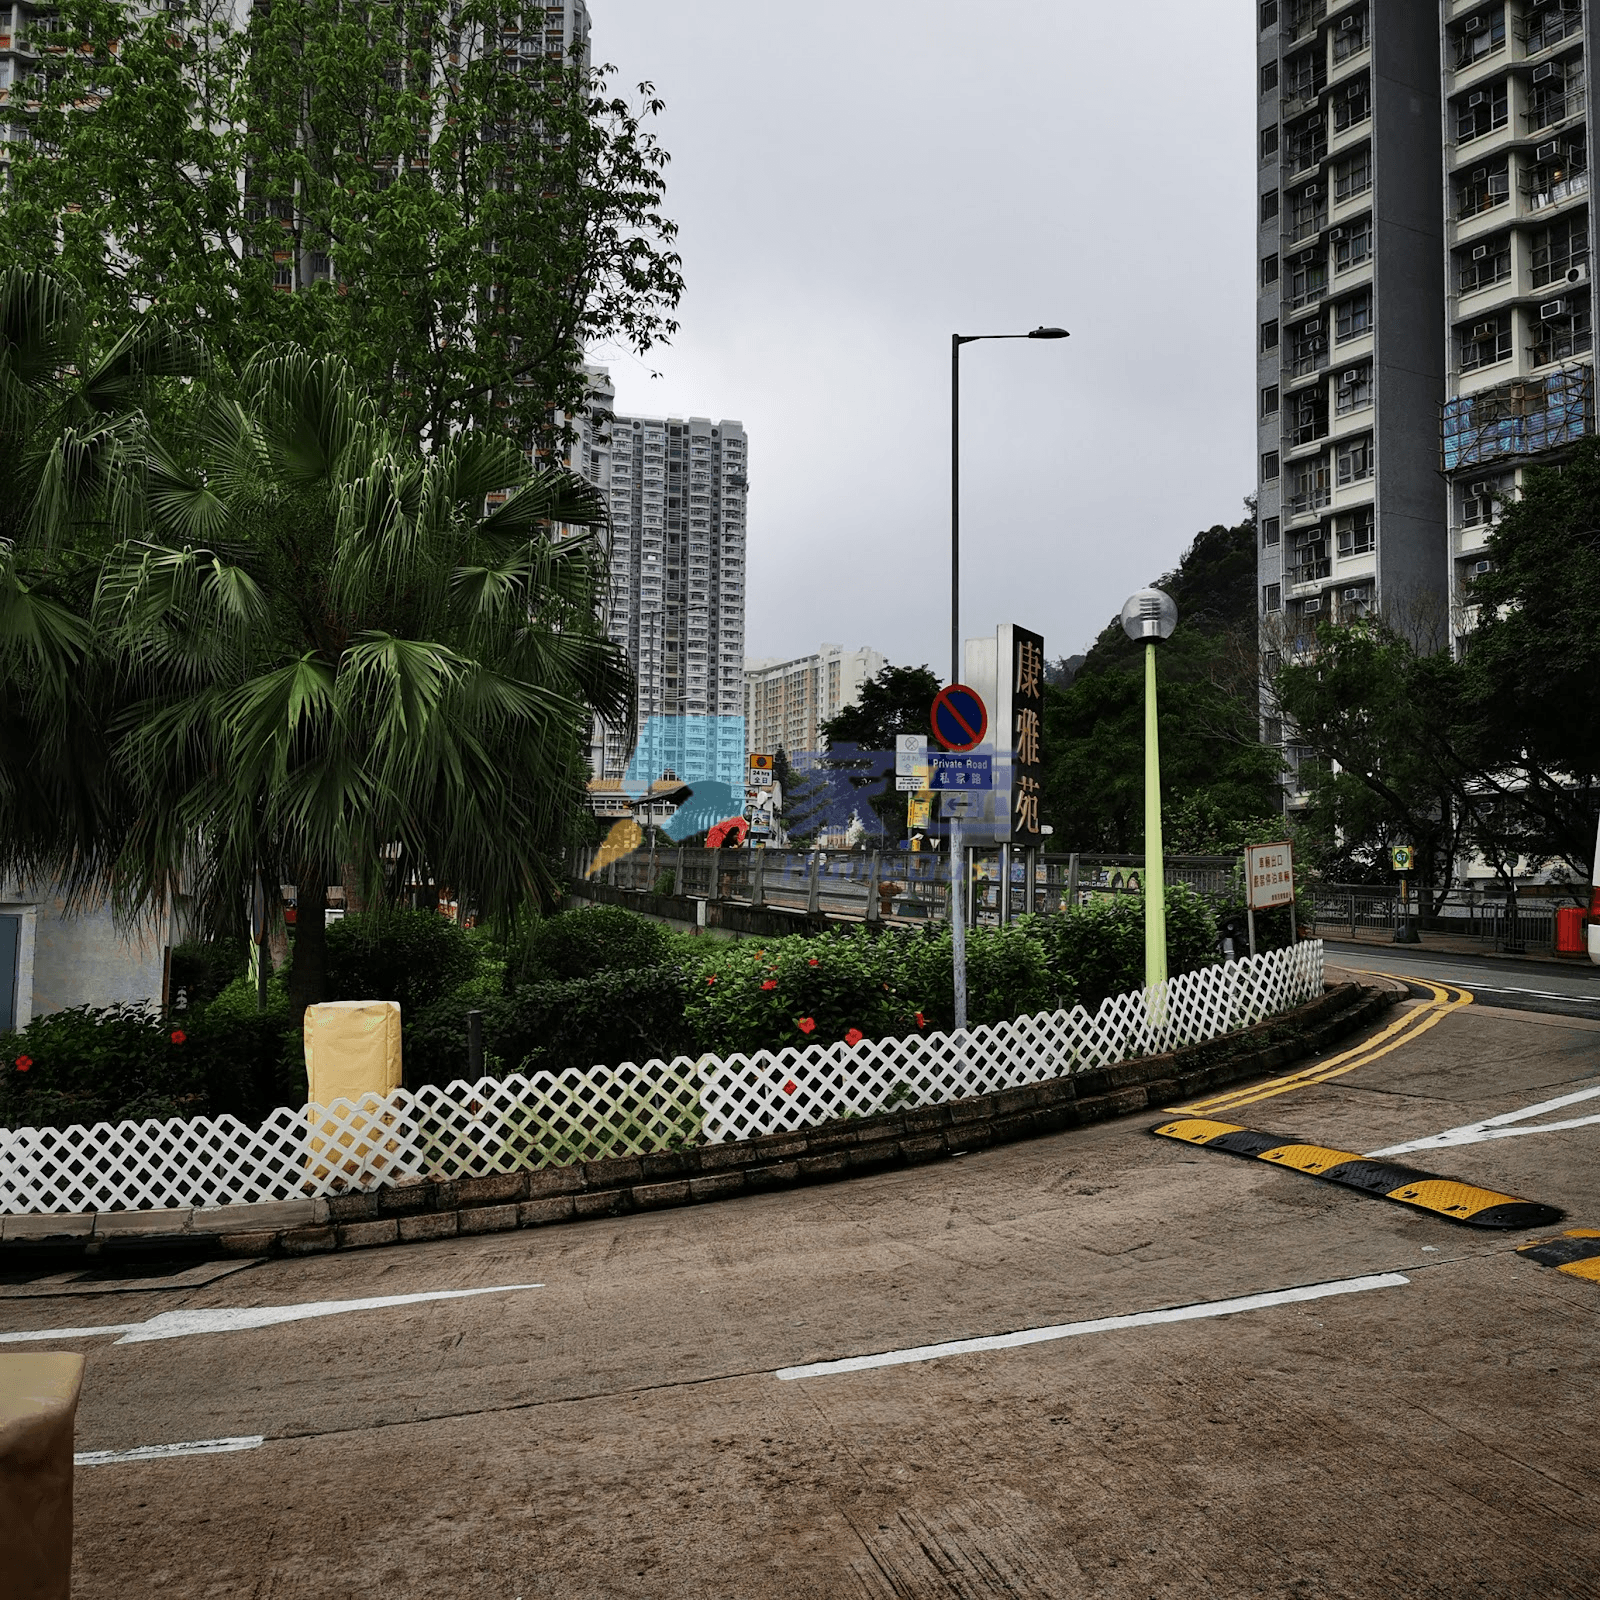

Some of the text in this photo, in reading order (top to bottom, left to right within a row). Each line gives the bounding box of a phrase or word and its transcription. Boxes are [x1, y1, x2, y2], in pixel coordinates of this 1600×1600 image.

[1015, 640, 1041, 834] 康雅苑
[901, 754, 911, 762] 24
[932, 757, 988, 770] Private Road
[754, 776, 768, 784] 全日
[939, 771, 982, 785] 私家路
[1258, 854, 1283, 870] 車輛出口
[1396, 853, 1407, 862] 87
[1253, 870, 1291, 888] 嚴禁停泊車輛
